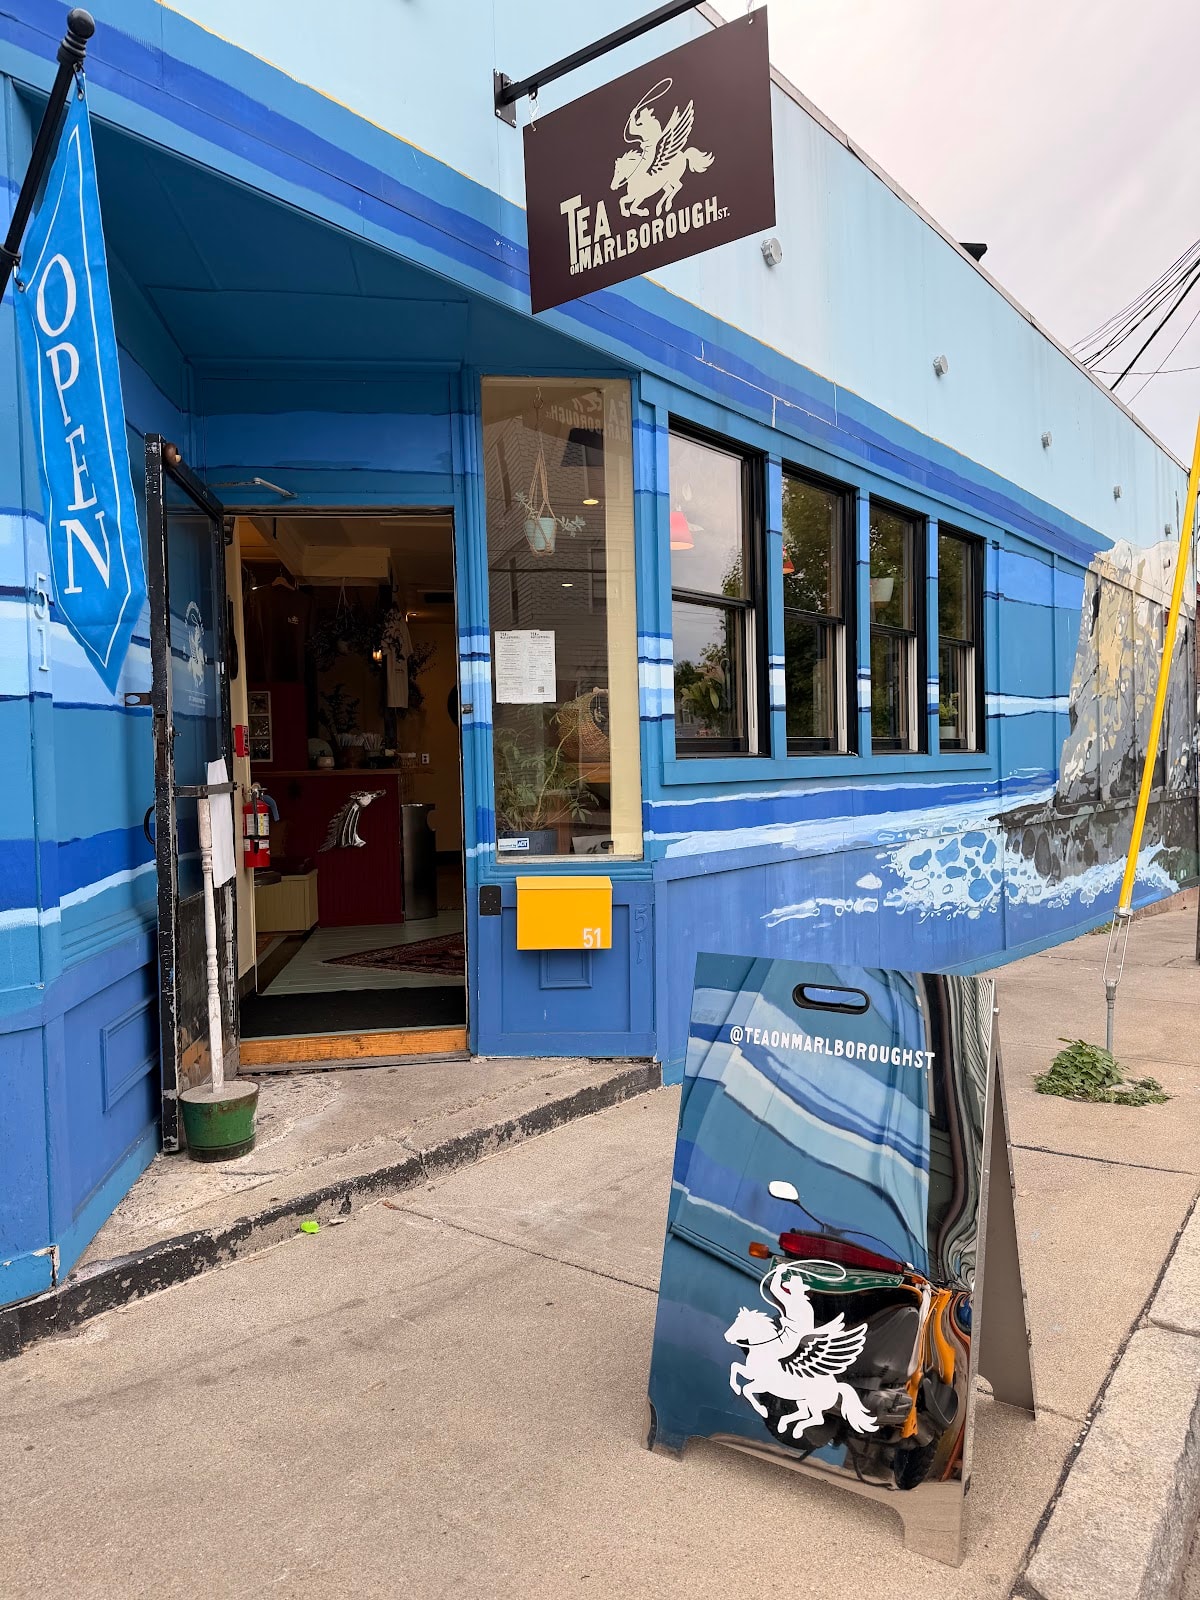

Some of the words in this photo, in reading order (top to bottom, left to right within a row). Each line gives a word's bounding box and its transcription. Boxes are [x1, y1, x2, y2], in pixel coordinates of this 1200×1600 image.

[560, 194, 611, 265] TEA
[578, 196, 718, 272] MARLBOROUGH
[36, 253, 111, 595] OPEN
[583, 928, 602, 948] 51
[729, 1025, 936, 1070] @TEAONMARLBOROUGHST
